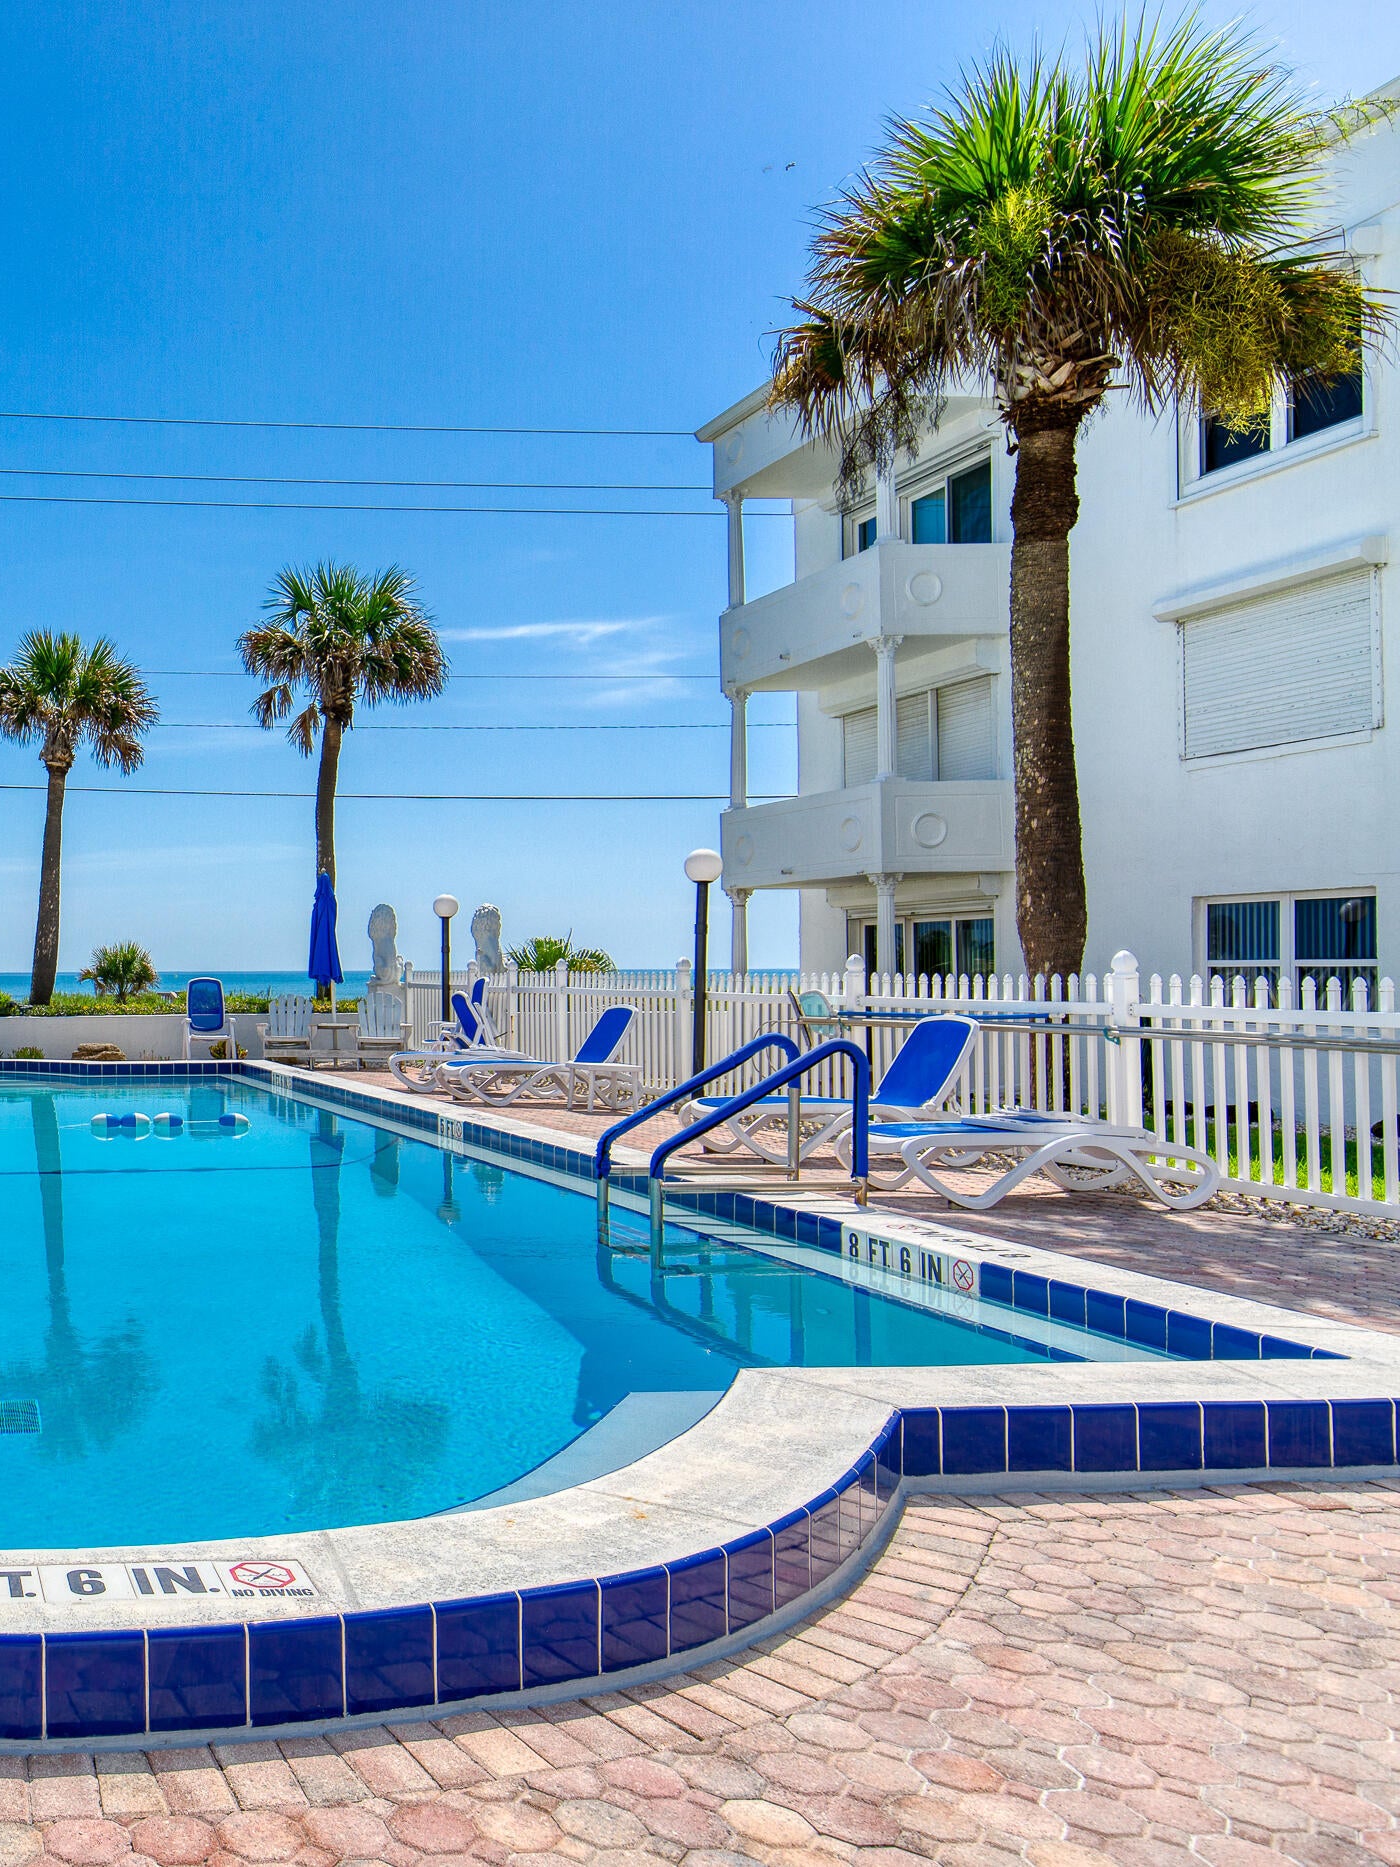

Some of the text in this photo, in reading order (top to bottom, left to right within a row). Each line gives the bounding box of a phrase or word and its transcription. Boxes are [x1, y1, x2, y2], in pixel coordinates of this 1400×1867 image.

[849, 1233, 859, 1258] 8
[900, 1246, 912, 1273] 6
[921, 1252, 946, 1285] IN.
[65, 1569, 107, 1596] 6
[131, 1566, 221, 1596] IN.
[231, 1587, 315, 1597] NO DIVING
